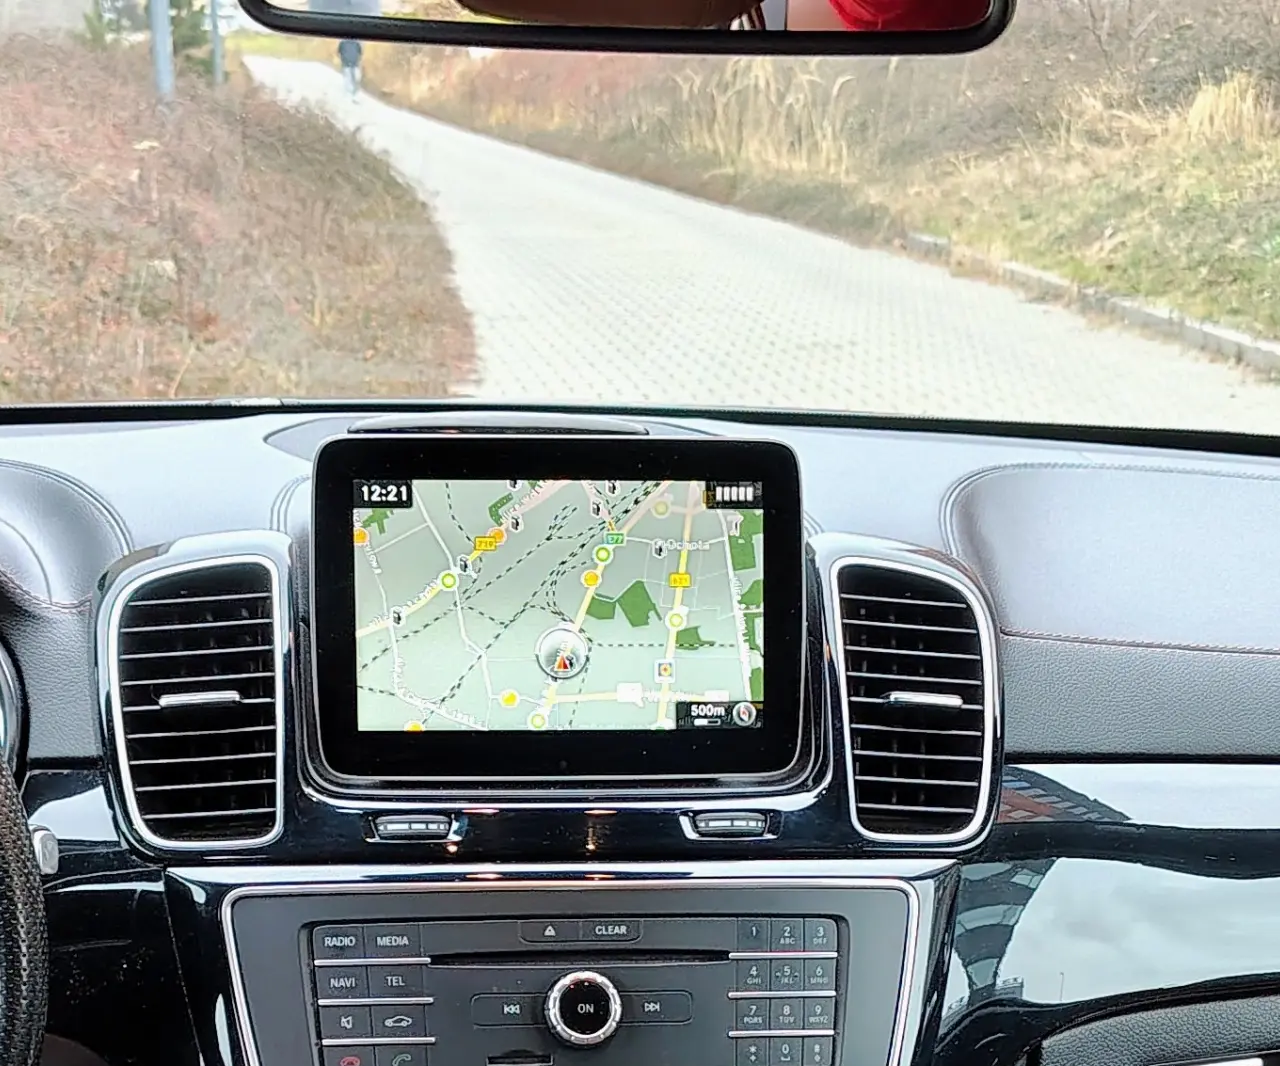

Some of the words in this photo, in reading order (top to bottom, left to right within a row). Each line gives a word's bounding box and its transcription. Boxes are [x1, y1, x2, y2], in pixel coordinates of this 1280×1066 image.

[361, 485, 408, 502] 12:21
[691, 705, 725, 716] 500m
[595, 925, 628, 936] CLEAR
[751, 927, 756, 936] 1
[783, 927, 791, 936] 2
[817, 926, 824, 936] 3
[324, 936, 356, 947] RADIO
[376, 936, 409, 947] MEDIA
[750, 966, 758, 975] 4
[784, 966, 791, 975] 5
[816, 966, 823, 975] 6
[330, 977, 356, 988] NAVI
[385, 976, 405, 987] TEL
[577, 1003, 594, 1014] ON
[750, 1005, 757, 1015] 7
[783, 1005, 791, 1015] 8
[815, 1005, 822, 1015] 9
[782, 1044, 789, 1054] 0
